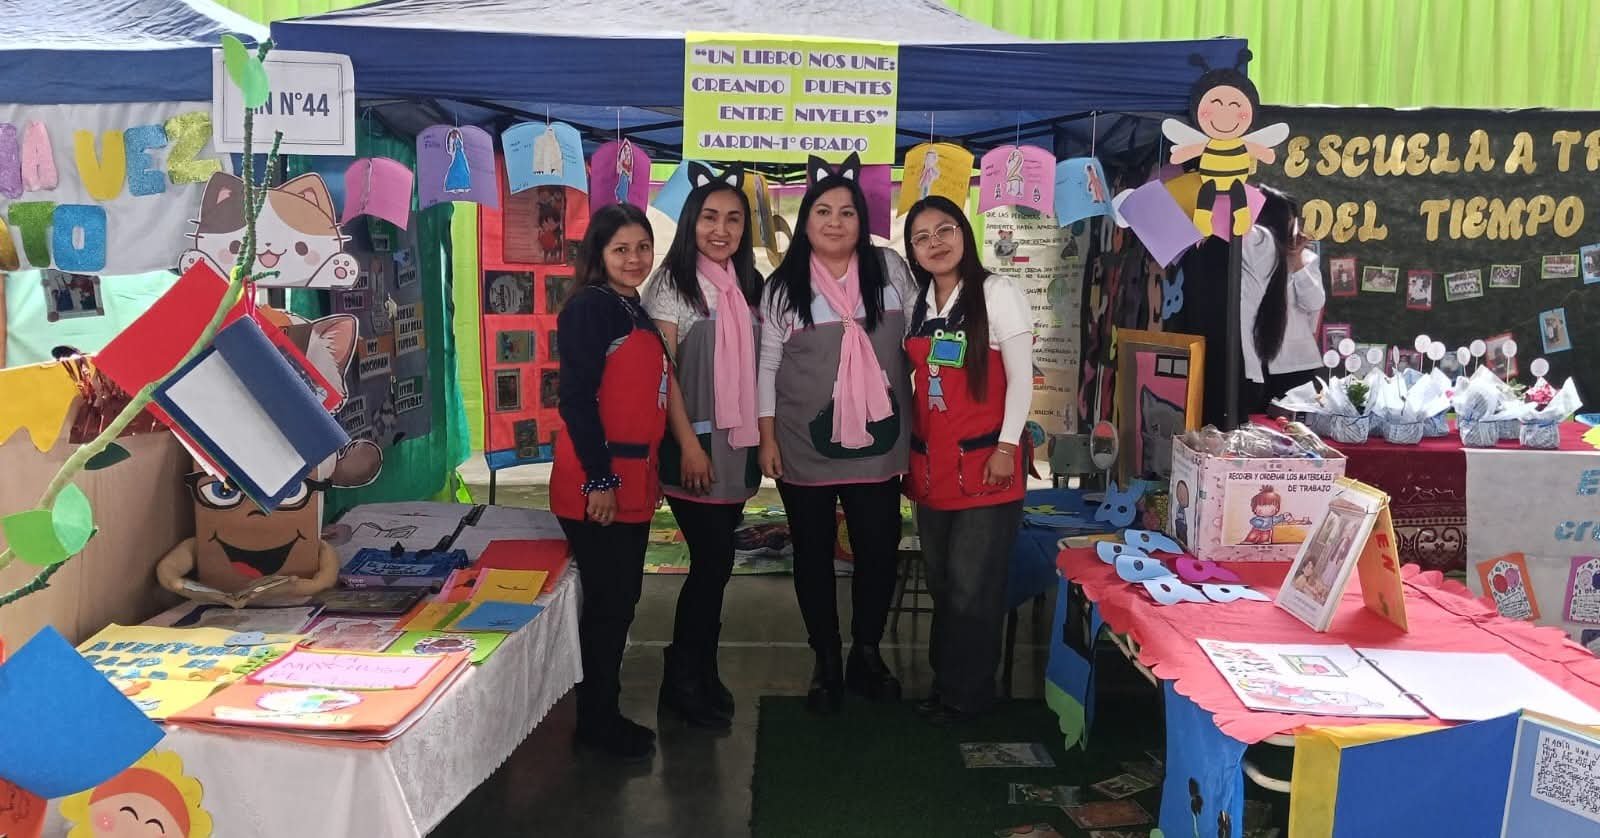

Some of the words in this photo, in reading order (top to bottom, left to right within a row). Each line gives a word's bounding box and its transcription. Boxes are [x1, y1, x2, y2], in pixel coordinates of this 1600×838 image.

[743, 50, 802, 65] LIBRO
[809, 53, 846, 69] NOS
[851, 56, 896, 71] UNE:
[692, 77, 785, 93] CREANDO
[805, 79, 892, 95] PUENTES
[280, 91, 330, 116] N°44
[719, 106, 784, 121] ENTRE
[800, 136, 868, 152] GRADO
[1284, 128, 1495, 178] ESCUELA
[1504, 131, 1537, 175] A
[73, 111, 224, 202] VEZ
[1301, 199, 1388, 243] DEL
[1420, 194, 1585, 242] TIEMPO
[1286, 473, 1297, 481] LOS
[1299, 473, 1332, 481] MATERIALES
